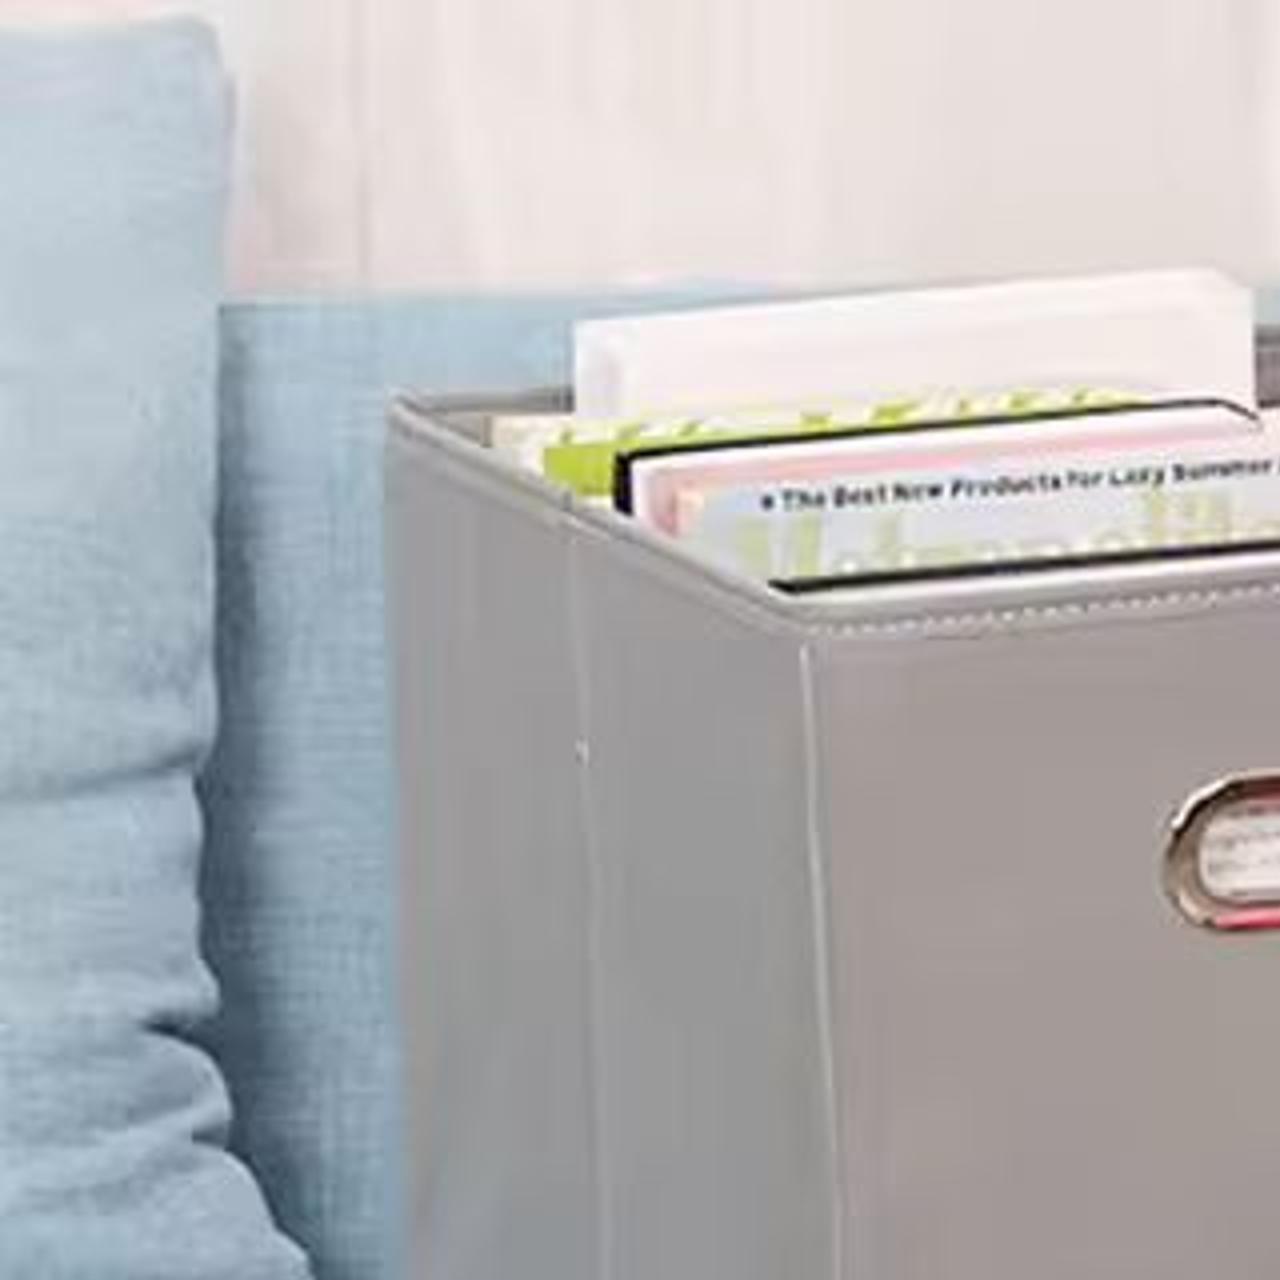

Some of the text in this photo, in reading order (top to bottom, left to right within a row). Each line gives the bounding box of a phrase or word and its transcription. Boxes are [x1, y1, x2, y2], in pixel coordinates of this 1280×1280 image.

[782, 489, 827, 510] The
[833, 484, 887, 507] Best
[893, 482, 943, 502] New
[951, 472, 1062, 499] Products
[1110, 468, 1166, 489] Lazy
[1173, 460, 1271, 482] Summer
